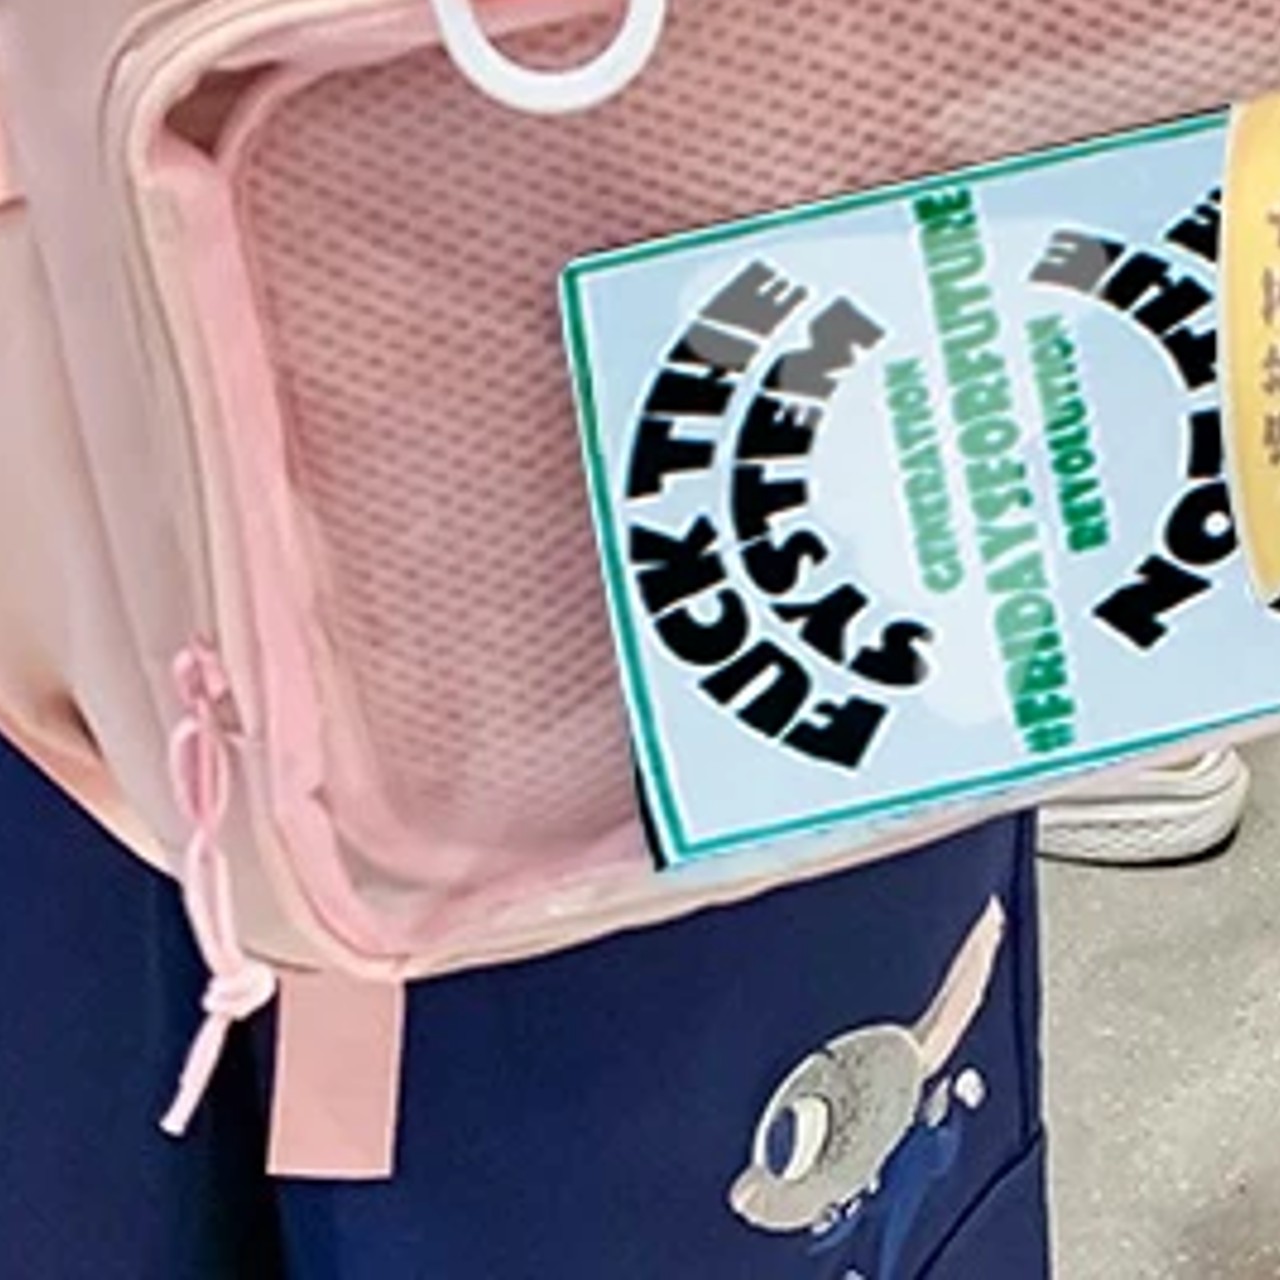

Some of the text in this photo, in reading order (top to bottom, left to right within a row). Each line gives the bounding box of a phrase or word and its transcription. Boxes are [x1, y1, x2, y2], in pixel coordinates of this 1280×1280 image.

[626, 260, 888, 770] FUCK THE
[732, 296, 933, 689] SYSTEM
[884, 357, 964, 593] GENERATION
[914, 187, 1076, 754] #FRIDAYSFORFUTURE
[1025, 313, 1109, 553] REVOLUTION
